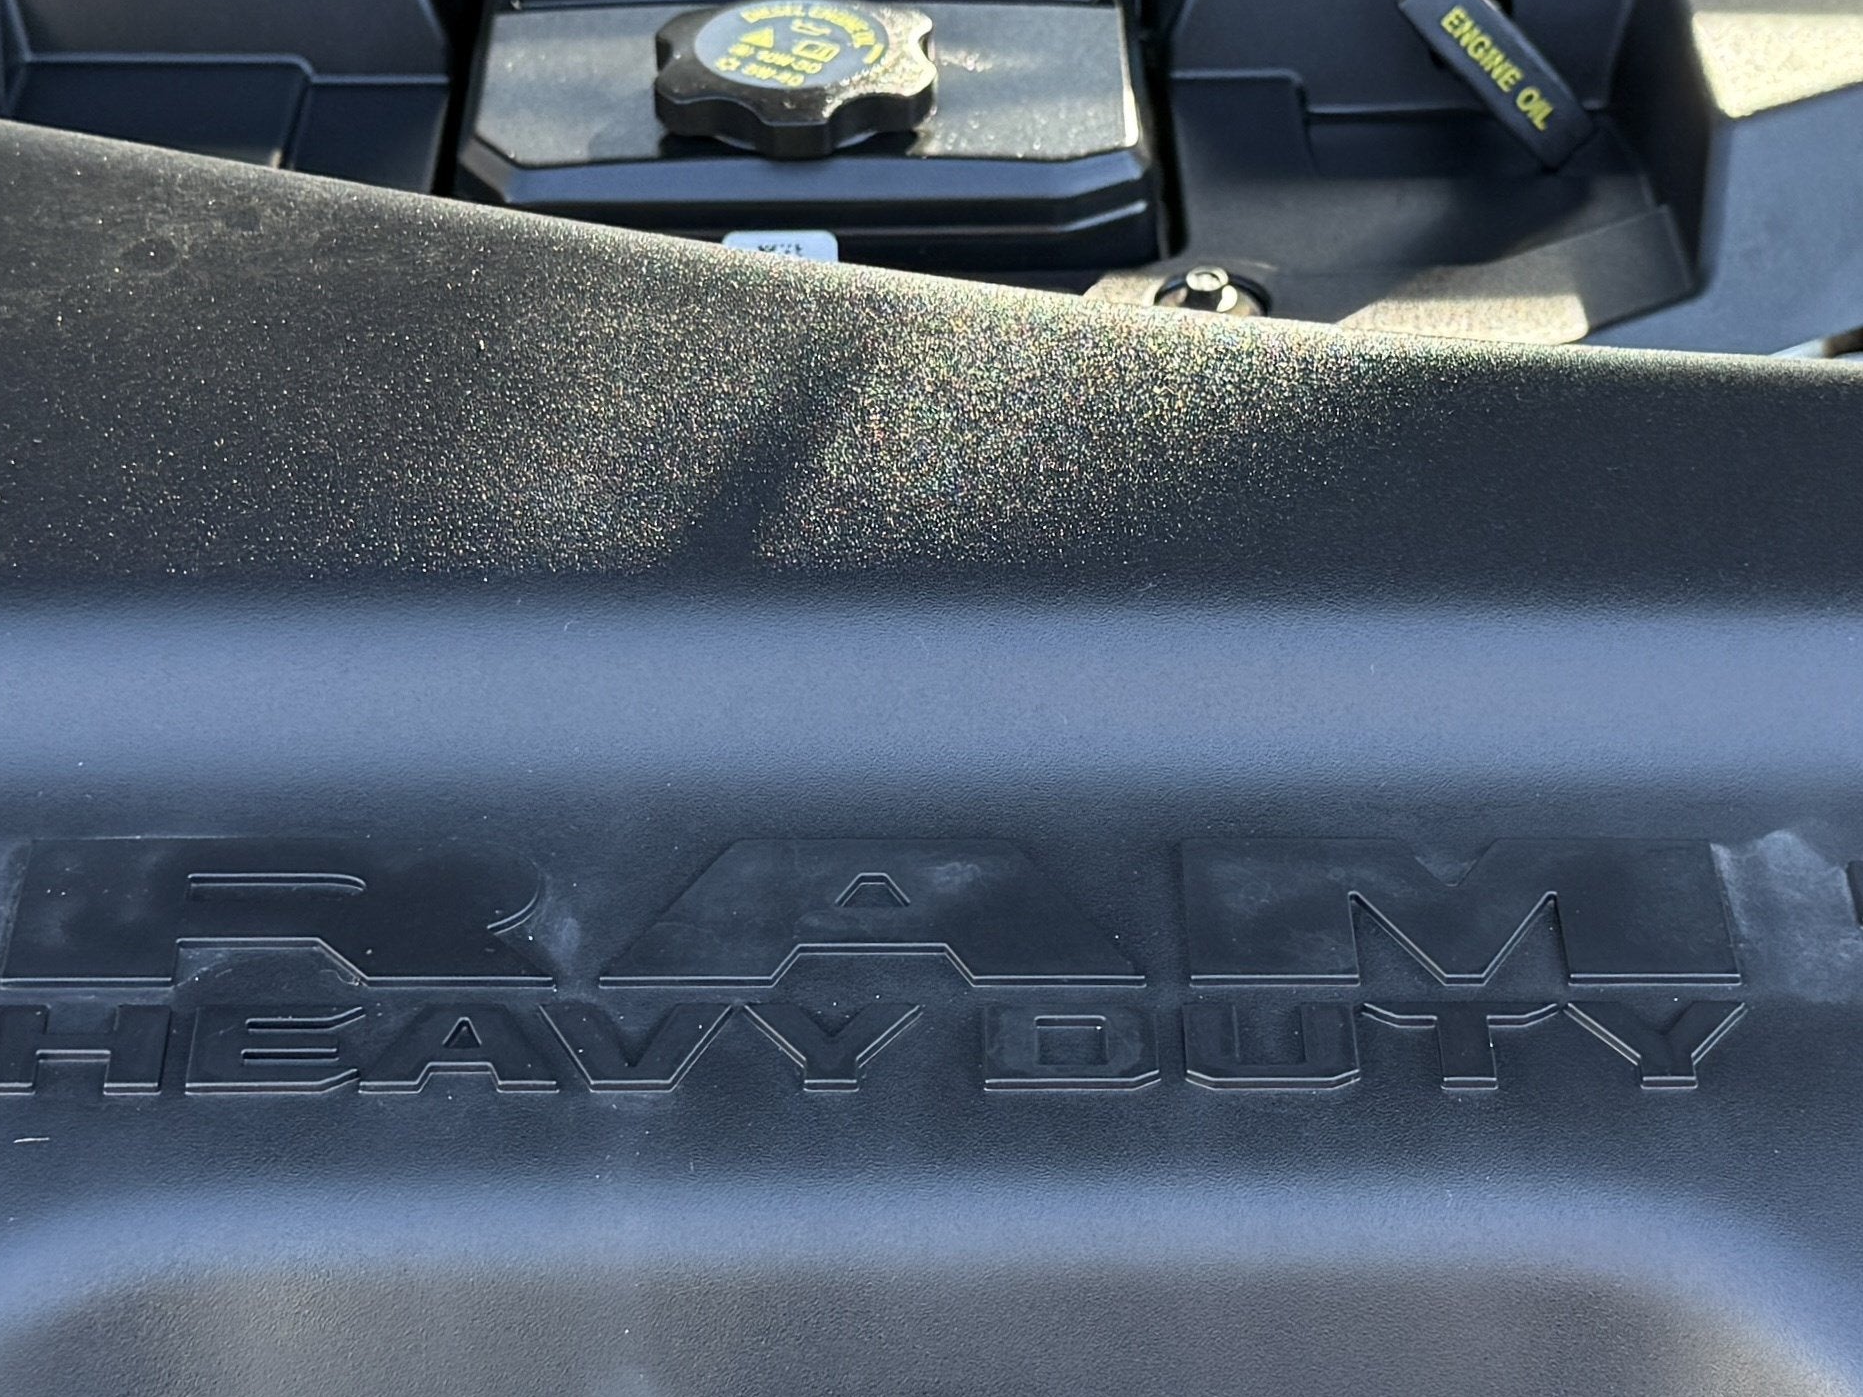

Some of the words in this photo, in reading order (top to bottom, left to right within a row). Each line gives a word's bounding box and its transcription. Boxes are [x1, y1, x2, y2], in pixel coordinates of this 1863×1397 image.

[1440, 5, 1524, 92] ENGINE
[1516, 85, 1554, 131] OIL
[982, 1003, 1747, 1093] DUTY
